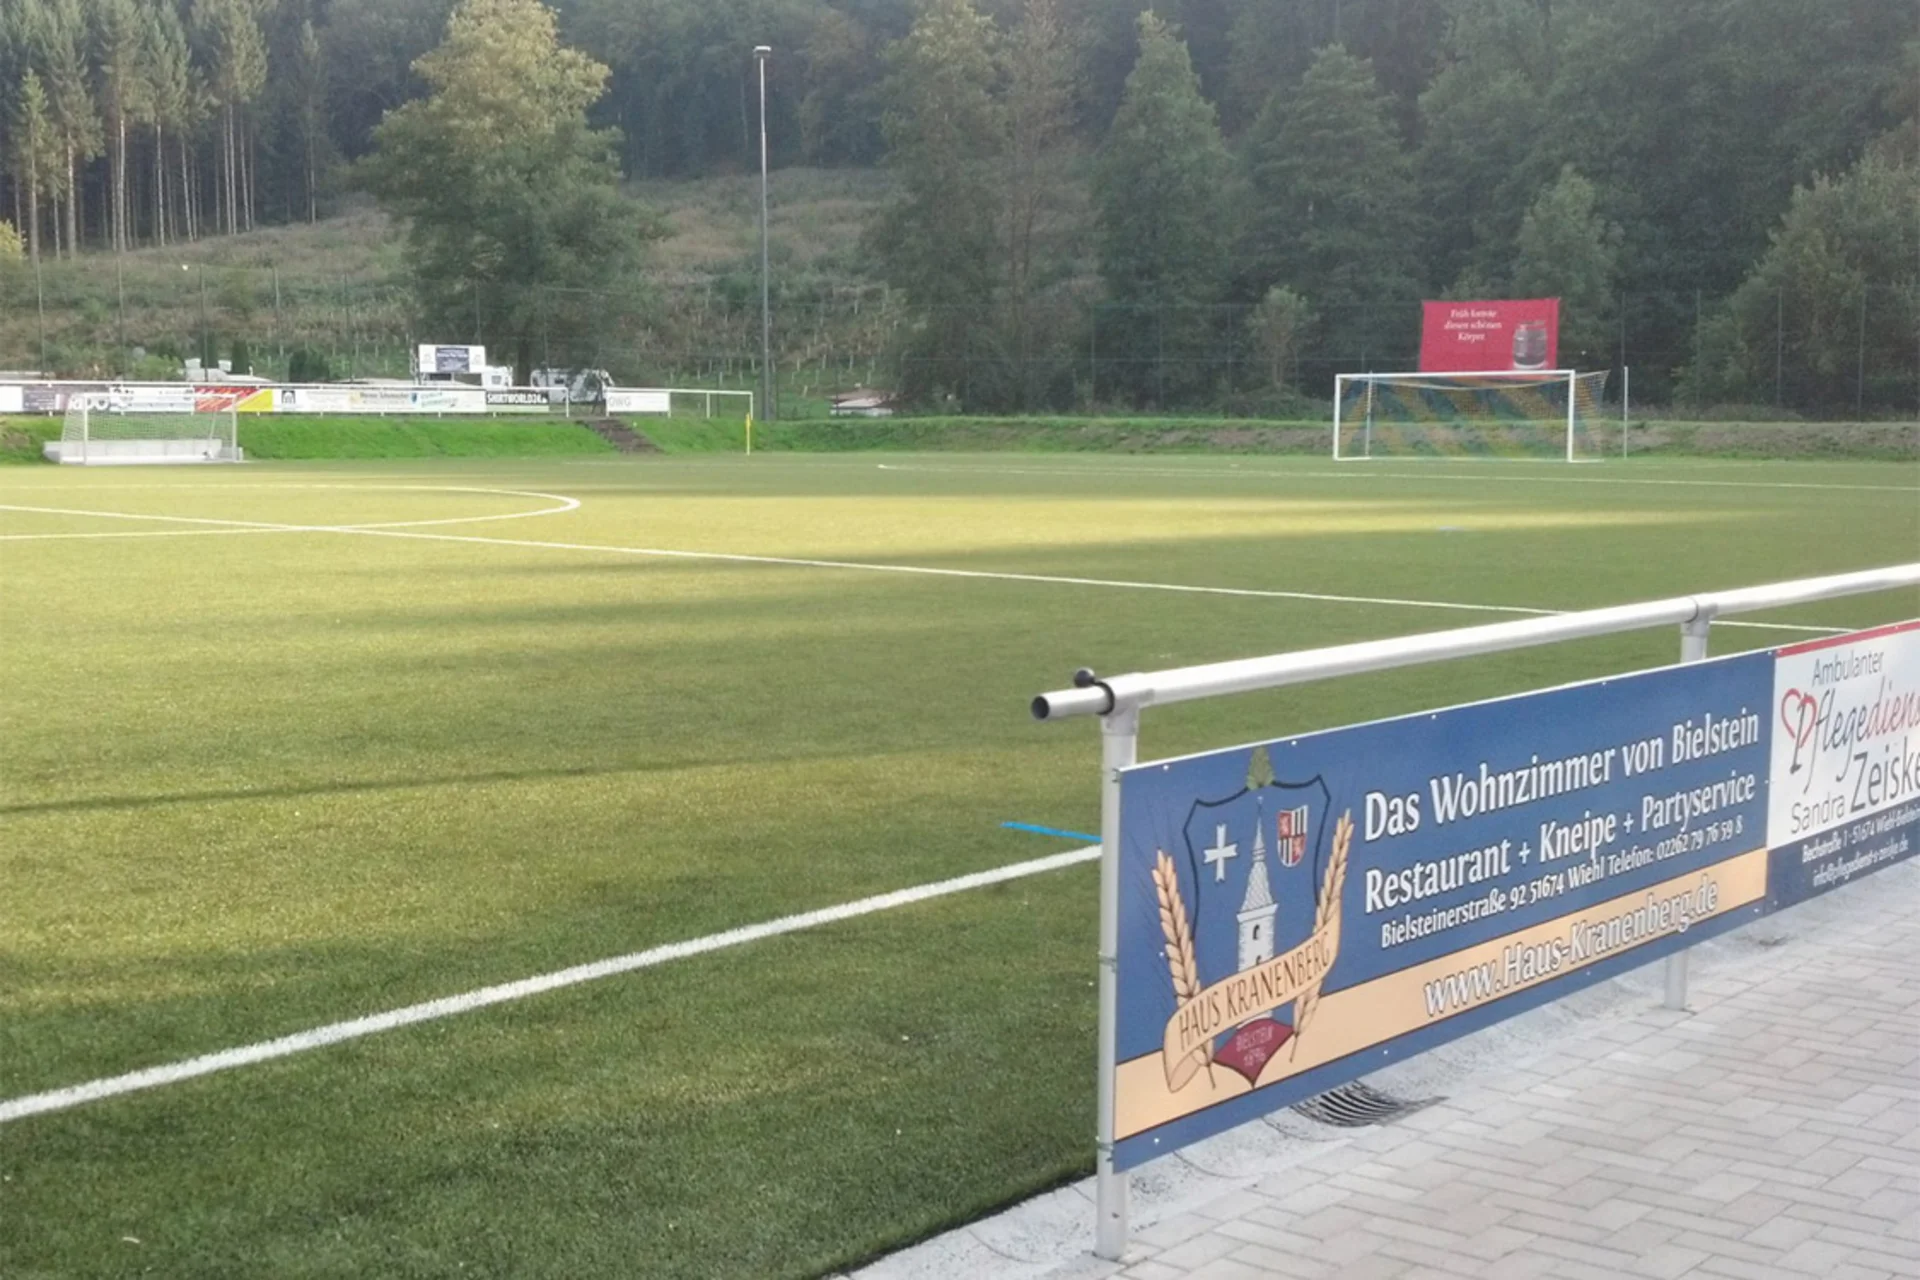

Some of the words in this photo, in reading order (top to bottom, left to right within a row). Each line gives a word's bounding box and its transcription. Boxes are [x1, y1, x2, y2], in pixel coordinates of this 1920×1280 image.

[1458, 331, 1486, 344] Körper
[1812, 652, 1885, 687] Ambulanter
[1365, 792, 1420, 841] Das
[1430, 749, 1615, 824] Wohnzimmer
[1622, 737, 1663, 777] von
[1671, 707, 1759, 764] Bielstein
[1791, 792, 1845, 834] Sandra
[1850, 736, 1920, 813] Zeiske
[1365, 839, 1511, 913] Restaurant
[1519, 842, 1531, 864] +
[1540, 811, 1616, 862] Kneipe
[1624, 812, 1635, 833] +
[1641, 770, 1755, 832] Partyservice
[1382, 888, 1506, 948] Bielsteinerstraße
[1510, 885, 1526, 910] 92
[1530, 872, 1565, 904] 51674
[1568, 860, 1605, 889] Wiehl
[1608, 845, 1653, 876] Telefon:
[1656, 832, 1688, 861] 02262
[1691, 829, 1704, 850] 79
[1706, 822, 1719, 845] 76
[1721, 818, 1733, 841] 59
[1179, 991, 1222, 1051] HAUS
[1226, 931, 1332, 1021] KRANENBERG
[1424, 873, 1718, 1017] www.Haus-Kranenberg.de
